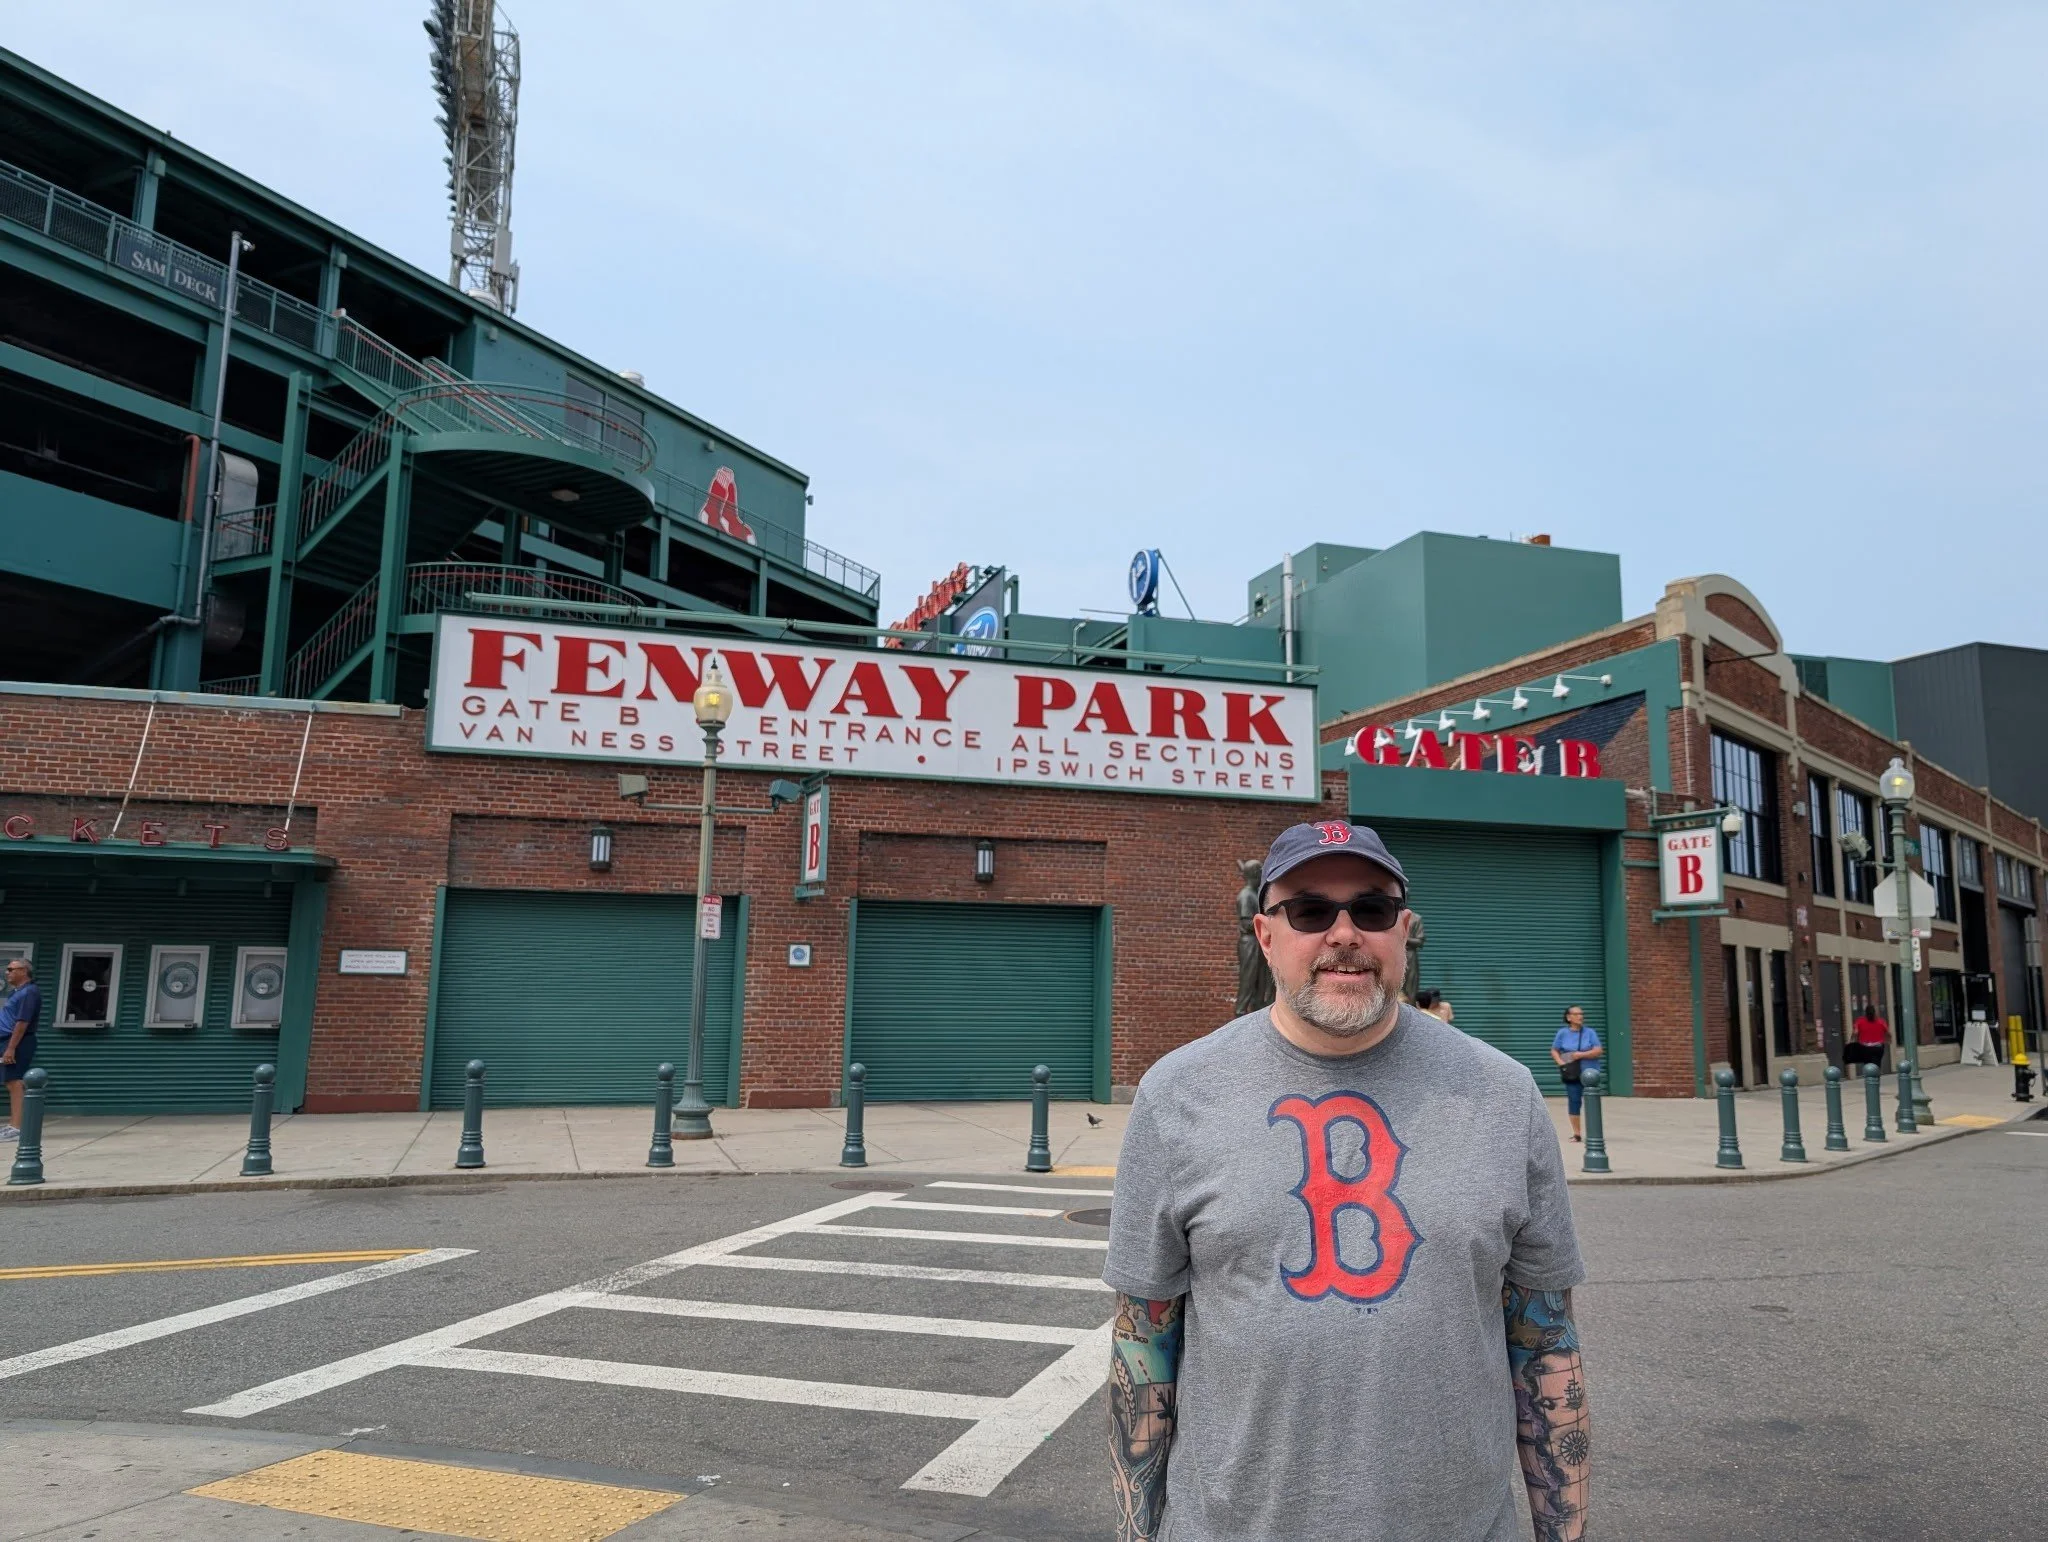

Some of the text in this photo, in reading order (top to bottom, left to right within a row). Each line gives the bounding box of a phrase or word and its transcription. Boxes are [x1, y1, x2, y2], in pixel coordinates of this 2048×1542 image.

[132, 251, 217, 302] SAM DECK
[464, 628, 1293, 746] FENWAY PARK
[459, 722, 1294, 790] VAN NESS STREET IPSWICH STREET
[462, 695, 1294, 770] GATE B ENTRANCE ALL SECTIONS
[1354, 723, 1603, 778] GATE B
[809, 799, 822, 815] GAT
[809, 823, 820, 869] B
[1314, 820, 1351, 845] B
[1668, 834, 1713, 851] GATE
[1677, 853, 1704, 895] B
[1267, 1089, 1427, 1305] B
[1131, 1334, 1148, 1343] TACO
